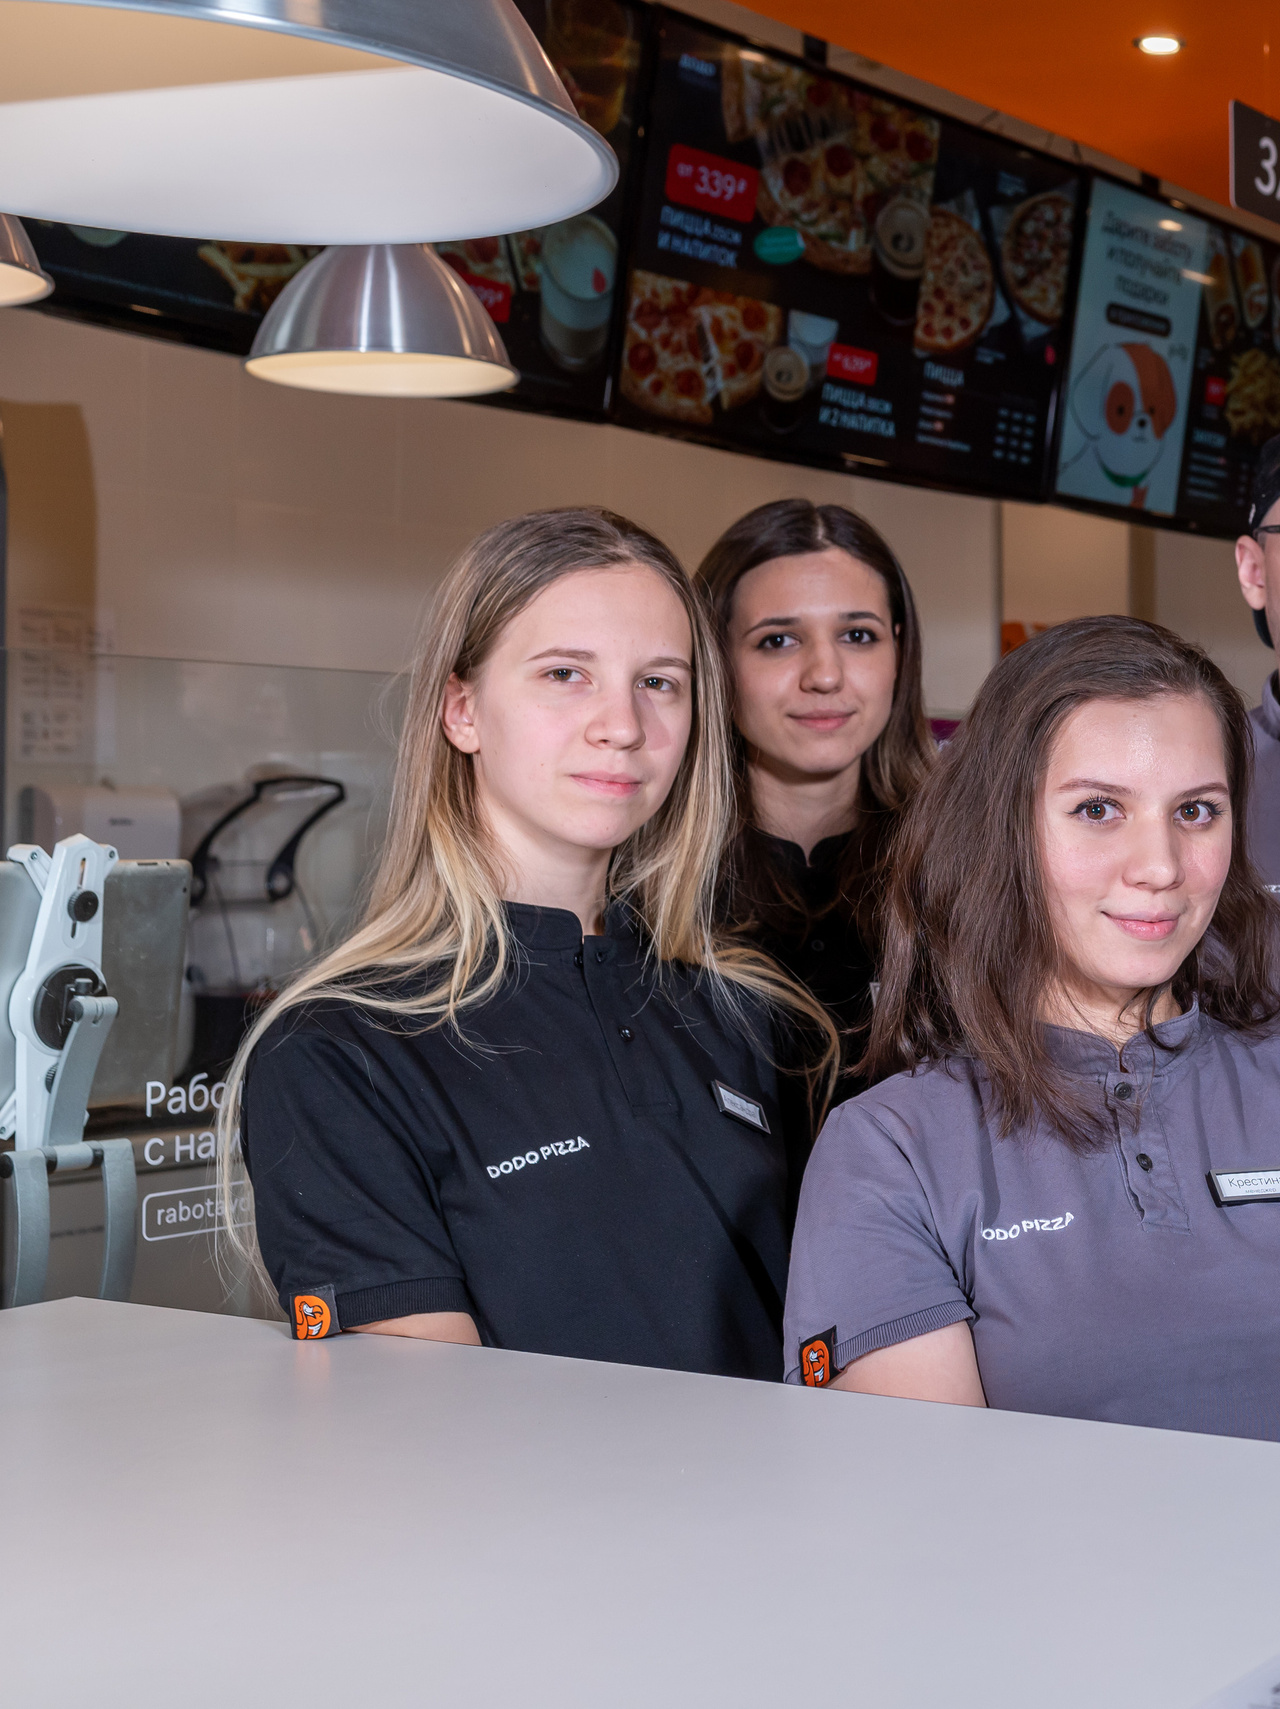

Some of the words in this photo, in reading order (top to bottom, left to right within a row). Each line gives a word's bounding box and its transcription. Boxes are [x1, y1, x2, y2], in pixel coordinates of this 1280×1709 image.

[660, 204, 711, 237] ПИЦЦА
[671, 233, 738, 268] НАПИТОК
[923, 360, 964, 387] ПИЦЦА
[821, 382, 866, 410] ПИЦЦА
[840, 411, 896, 438] НАПИТКА
[486, 1150, 540, 1179] DODO
[540, 1136, 590, 1160] PIZZA
[981, 1222, 1020, 1240] ODO
[1021, 1212, 1075, 1232] PIZZA
